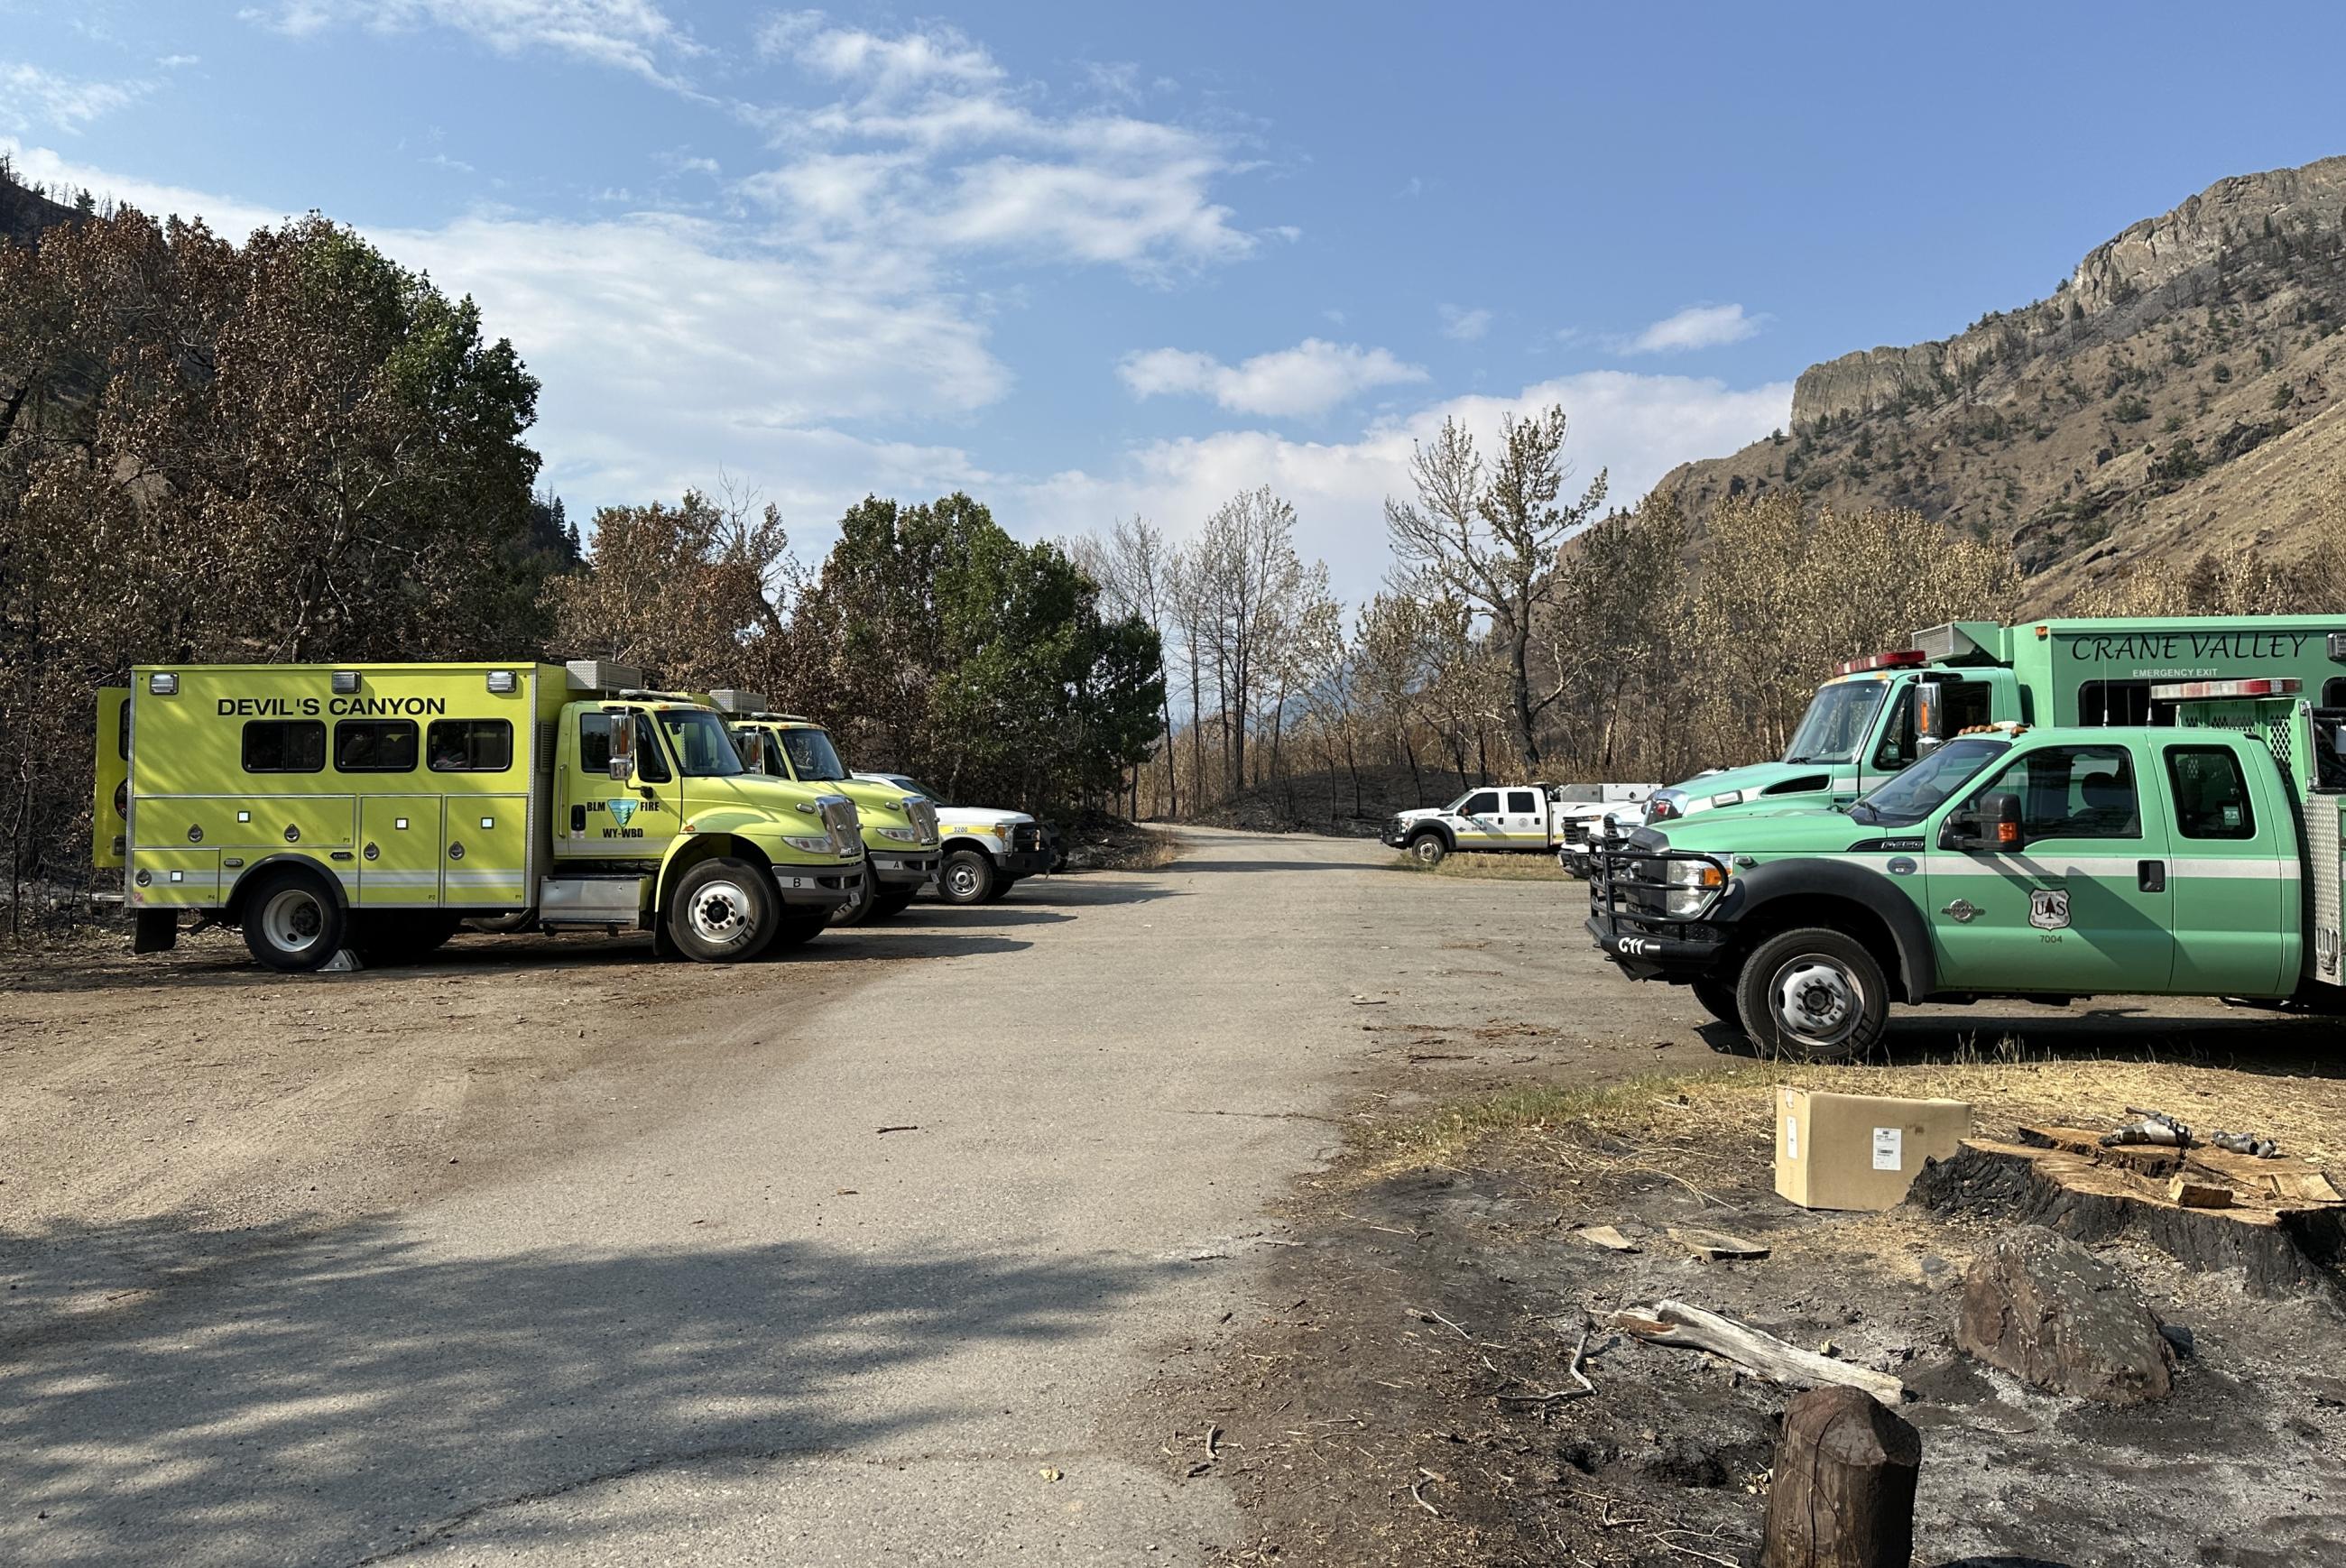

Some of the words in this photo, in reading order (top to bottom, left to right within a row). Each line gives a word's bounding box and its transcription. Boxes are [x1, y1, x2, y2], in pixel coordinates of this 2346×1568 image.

[2072, 633, 2180, 661] CRANE
[2190, 632, 2308, 659] VALLEY
[2132, 669, 2194, 678] EMERGENCY
[2196, 669, 2218, 677] EXIT
[217, 697, 320, 715] DEVIL'S
[328, 697, 446, 715] CANYON
[586, 802, 605, 811] BLM
[641, 802, 659, 811] FIRE
[603, 828, 643, 838] WY-WBD
[793, 878, 801, 888] B
[2039, 935, 2063, 944] 7004
[1618, 936, 1645, 955] C11
